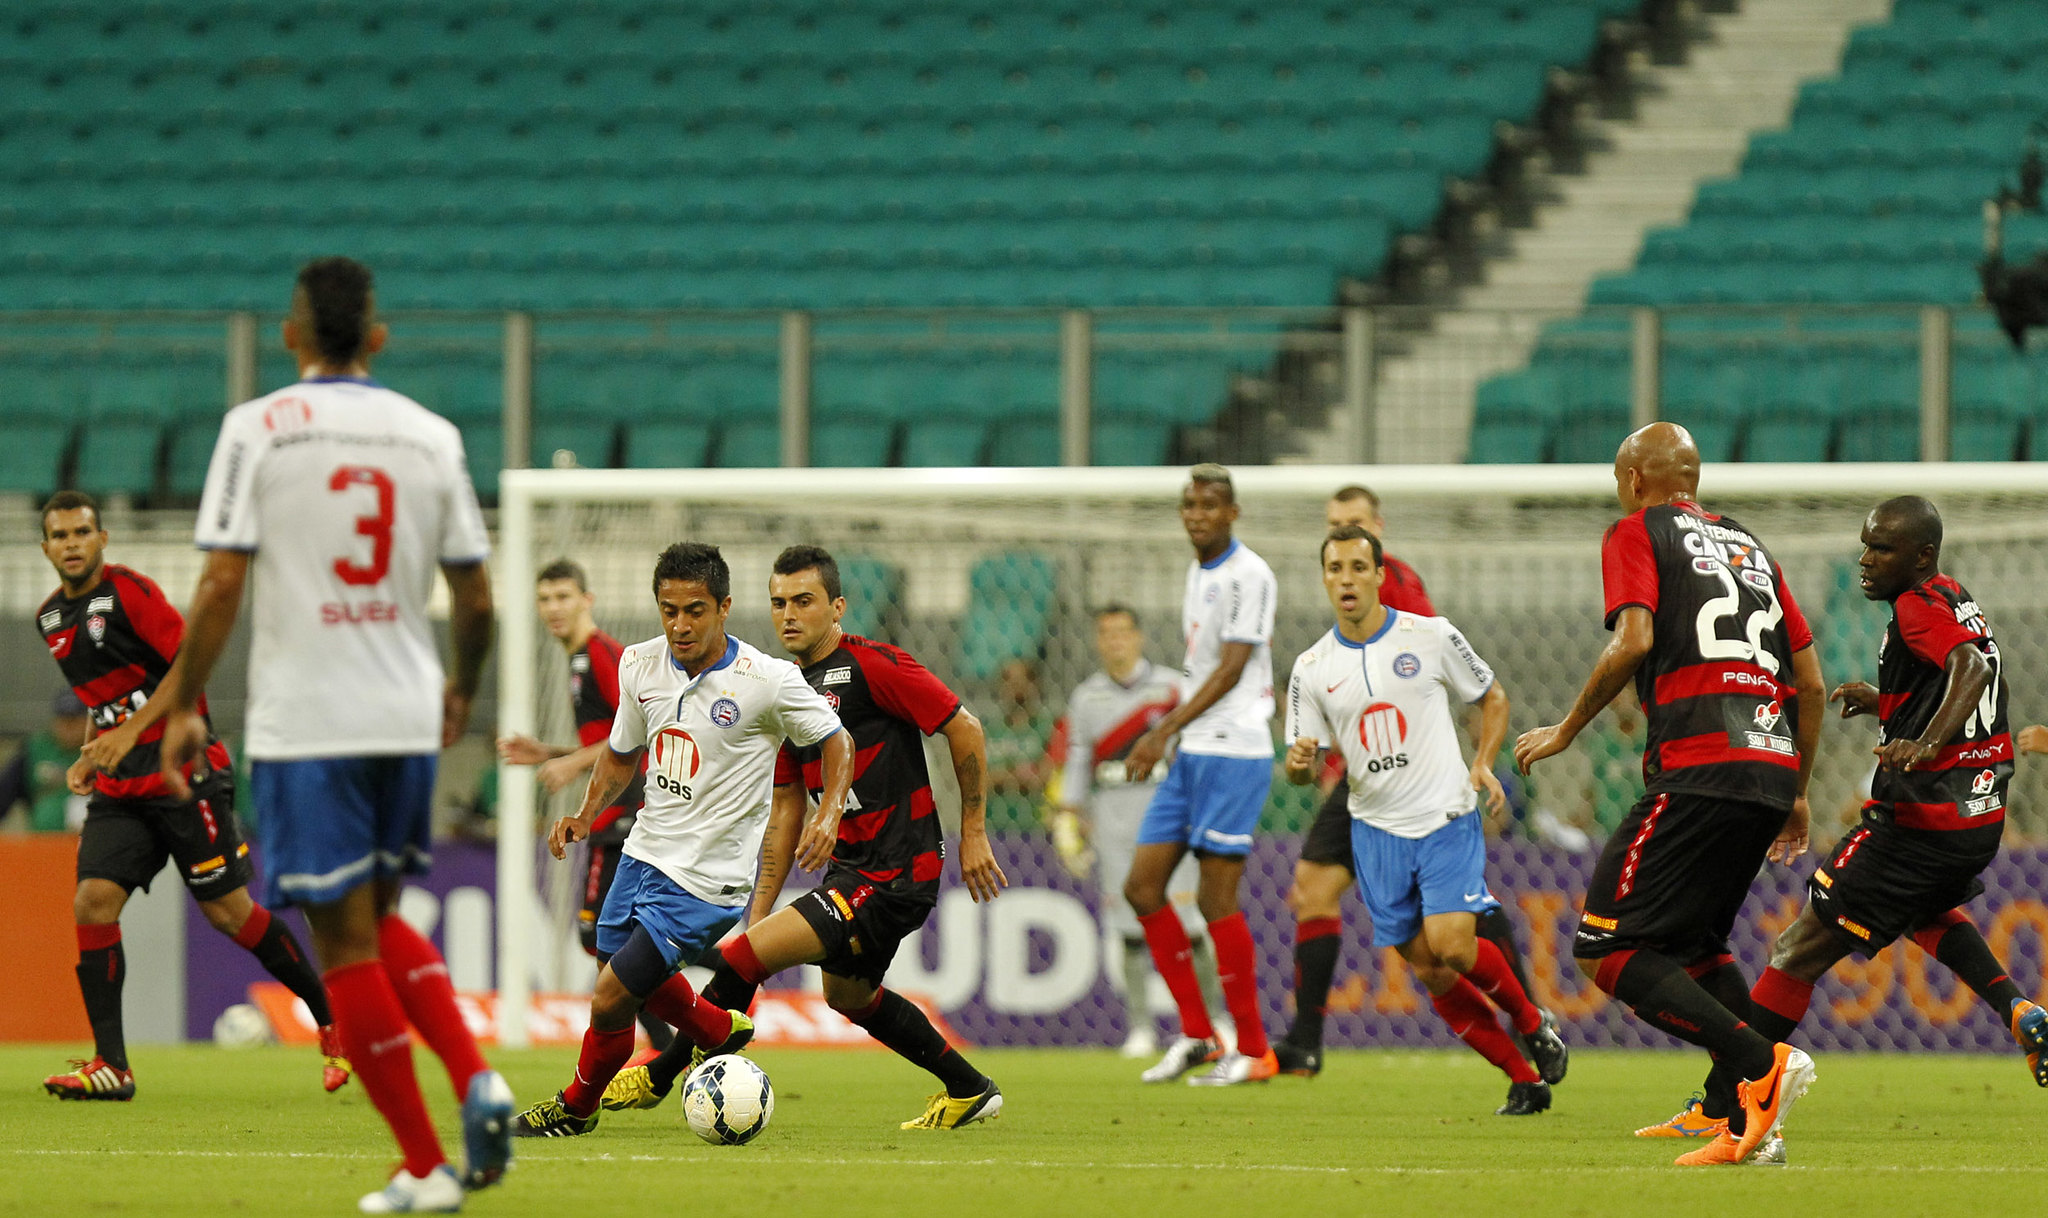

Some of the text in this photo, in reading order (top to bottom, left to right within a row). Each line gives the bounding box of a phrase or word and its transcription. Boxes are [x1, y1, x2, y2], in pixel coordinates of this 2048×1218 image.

[328, 465, 395, 587] 3
[1692, 555, 1784, 676] 22
[657, 775, 692, 801] oas
[1368, 752, 1409, 773] oas
